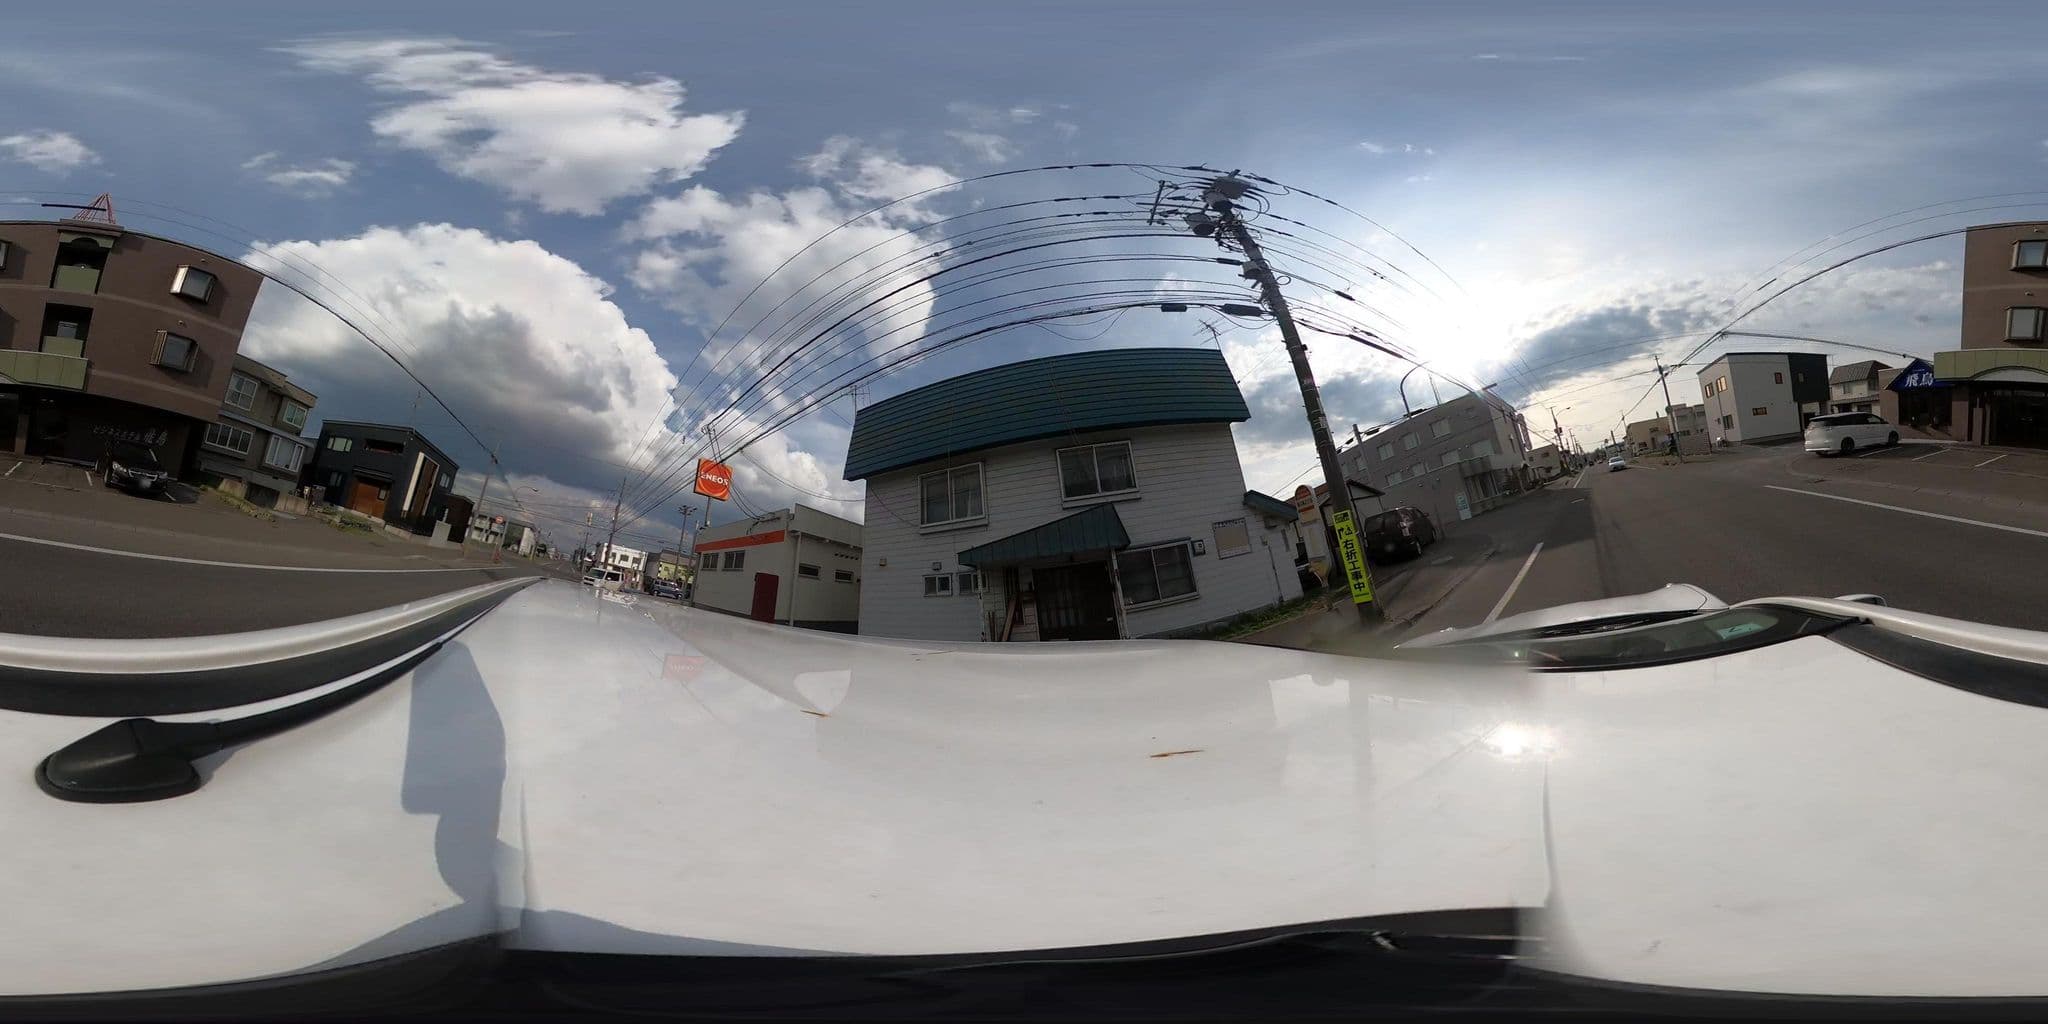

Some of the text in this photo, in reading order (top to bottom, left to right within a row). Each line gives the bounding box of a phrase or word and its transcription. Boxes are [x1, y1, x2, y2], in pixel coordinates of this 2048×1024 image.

[1343, 539, 1365, 591] 右折工事中
